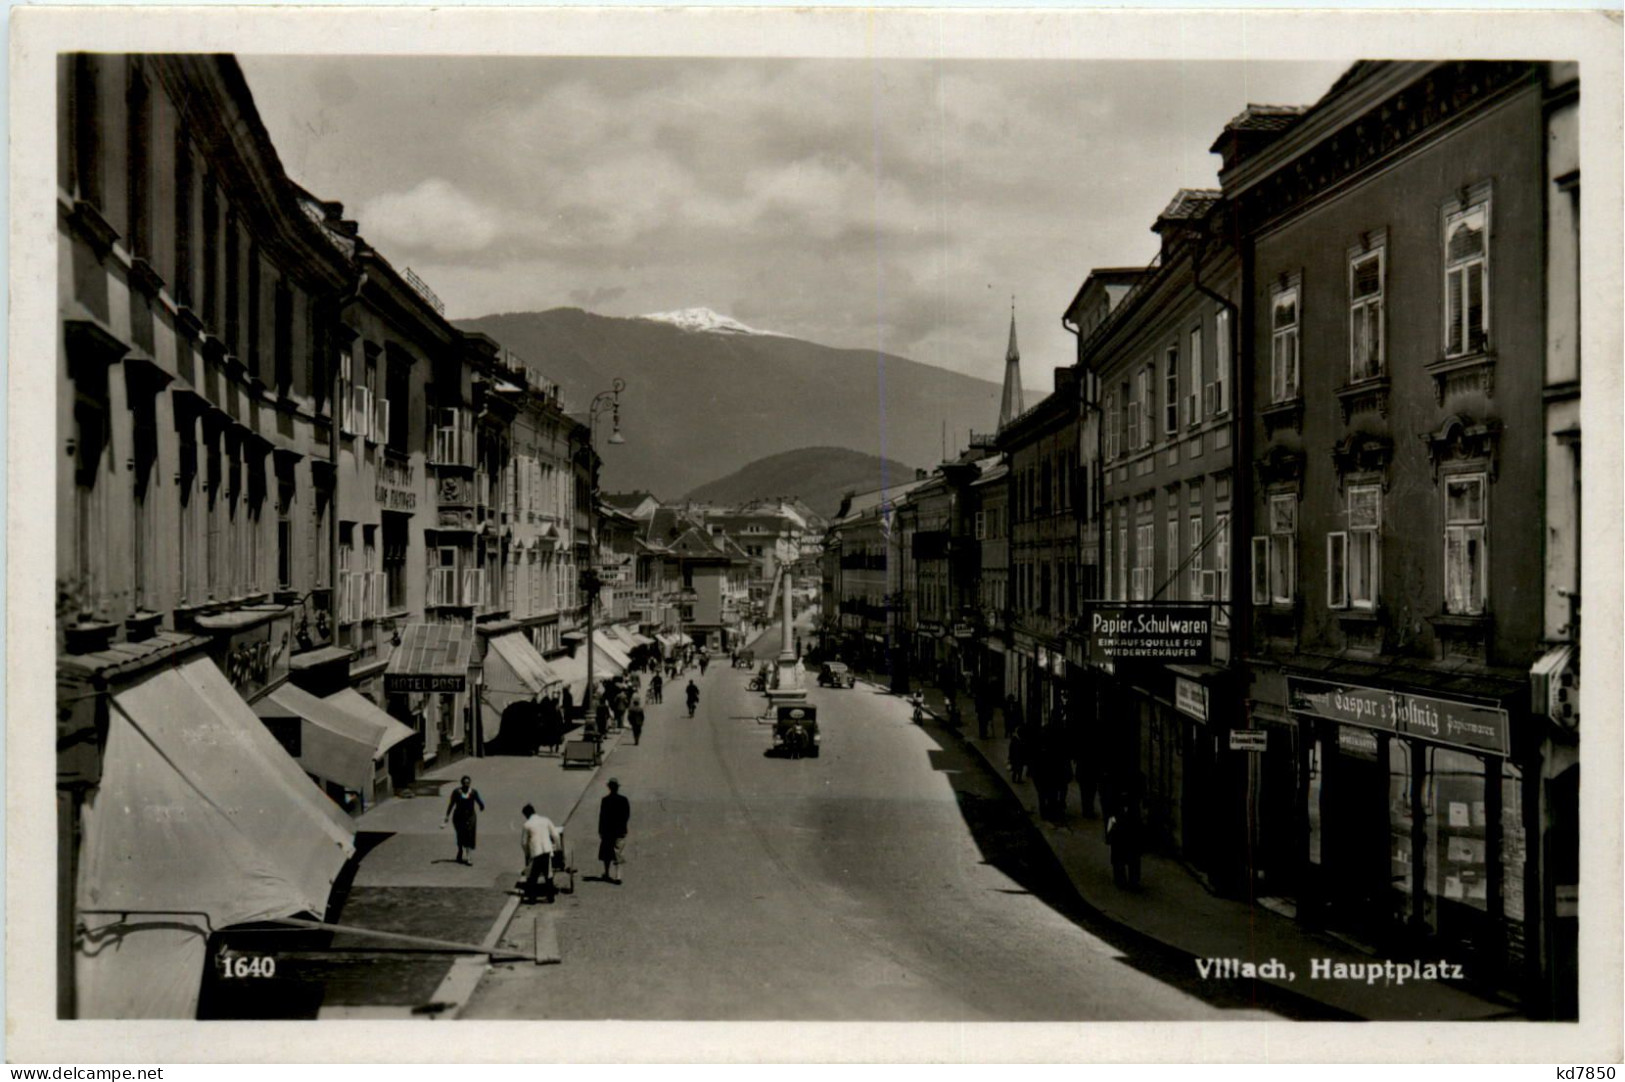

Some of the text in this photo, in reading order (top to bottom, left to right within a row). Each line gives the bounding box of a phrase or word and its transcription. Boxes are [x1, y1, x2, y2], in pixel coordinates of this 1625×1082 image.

[1098, 638, 1181, 648] EINKAUFSQUELLE
[391, 677, 462, 690] HOTEL POST
[1334, 687, 1378, 719] Caspar
